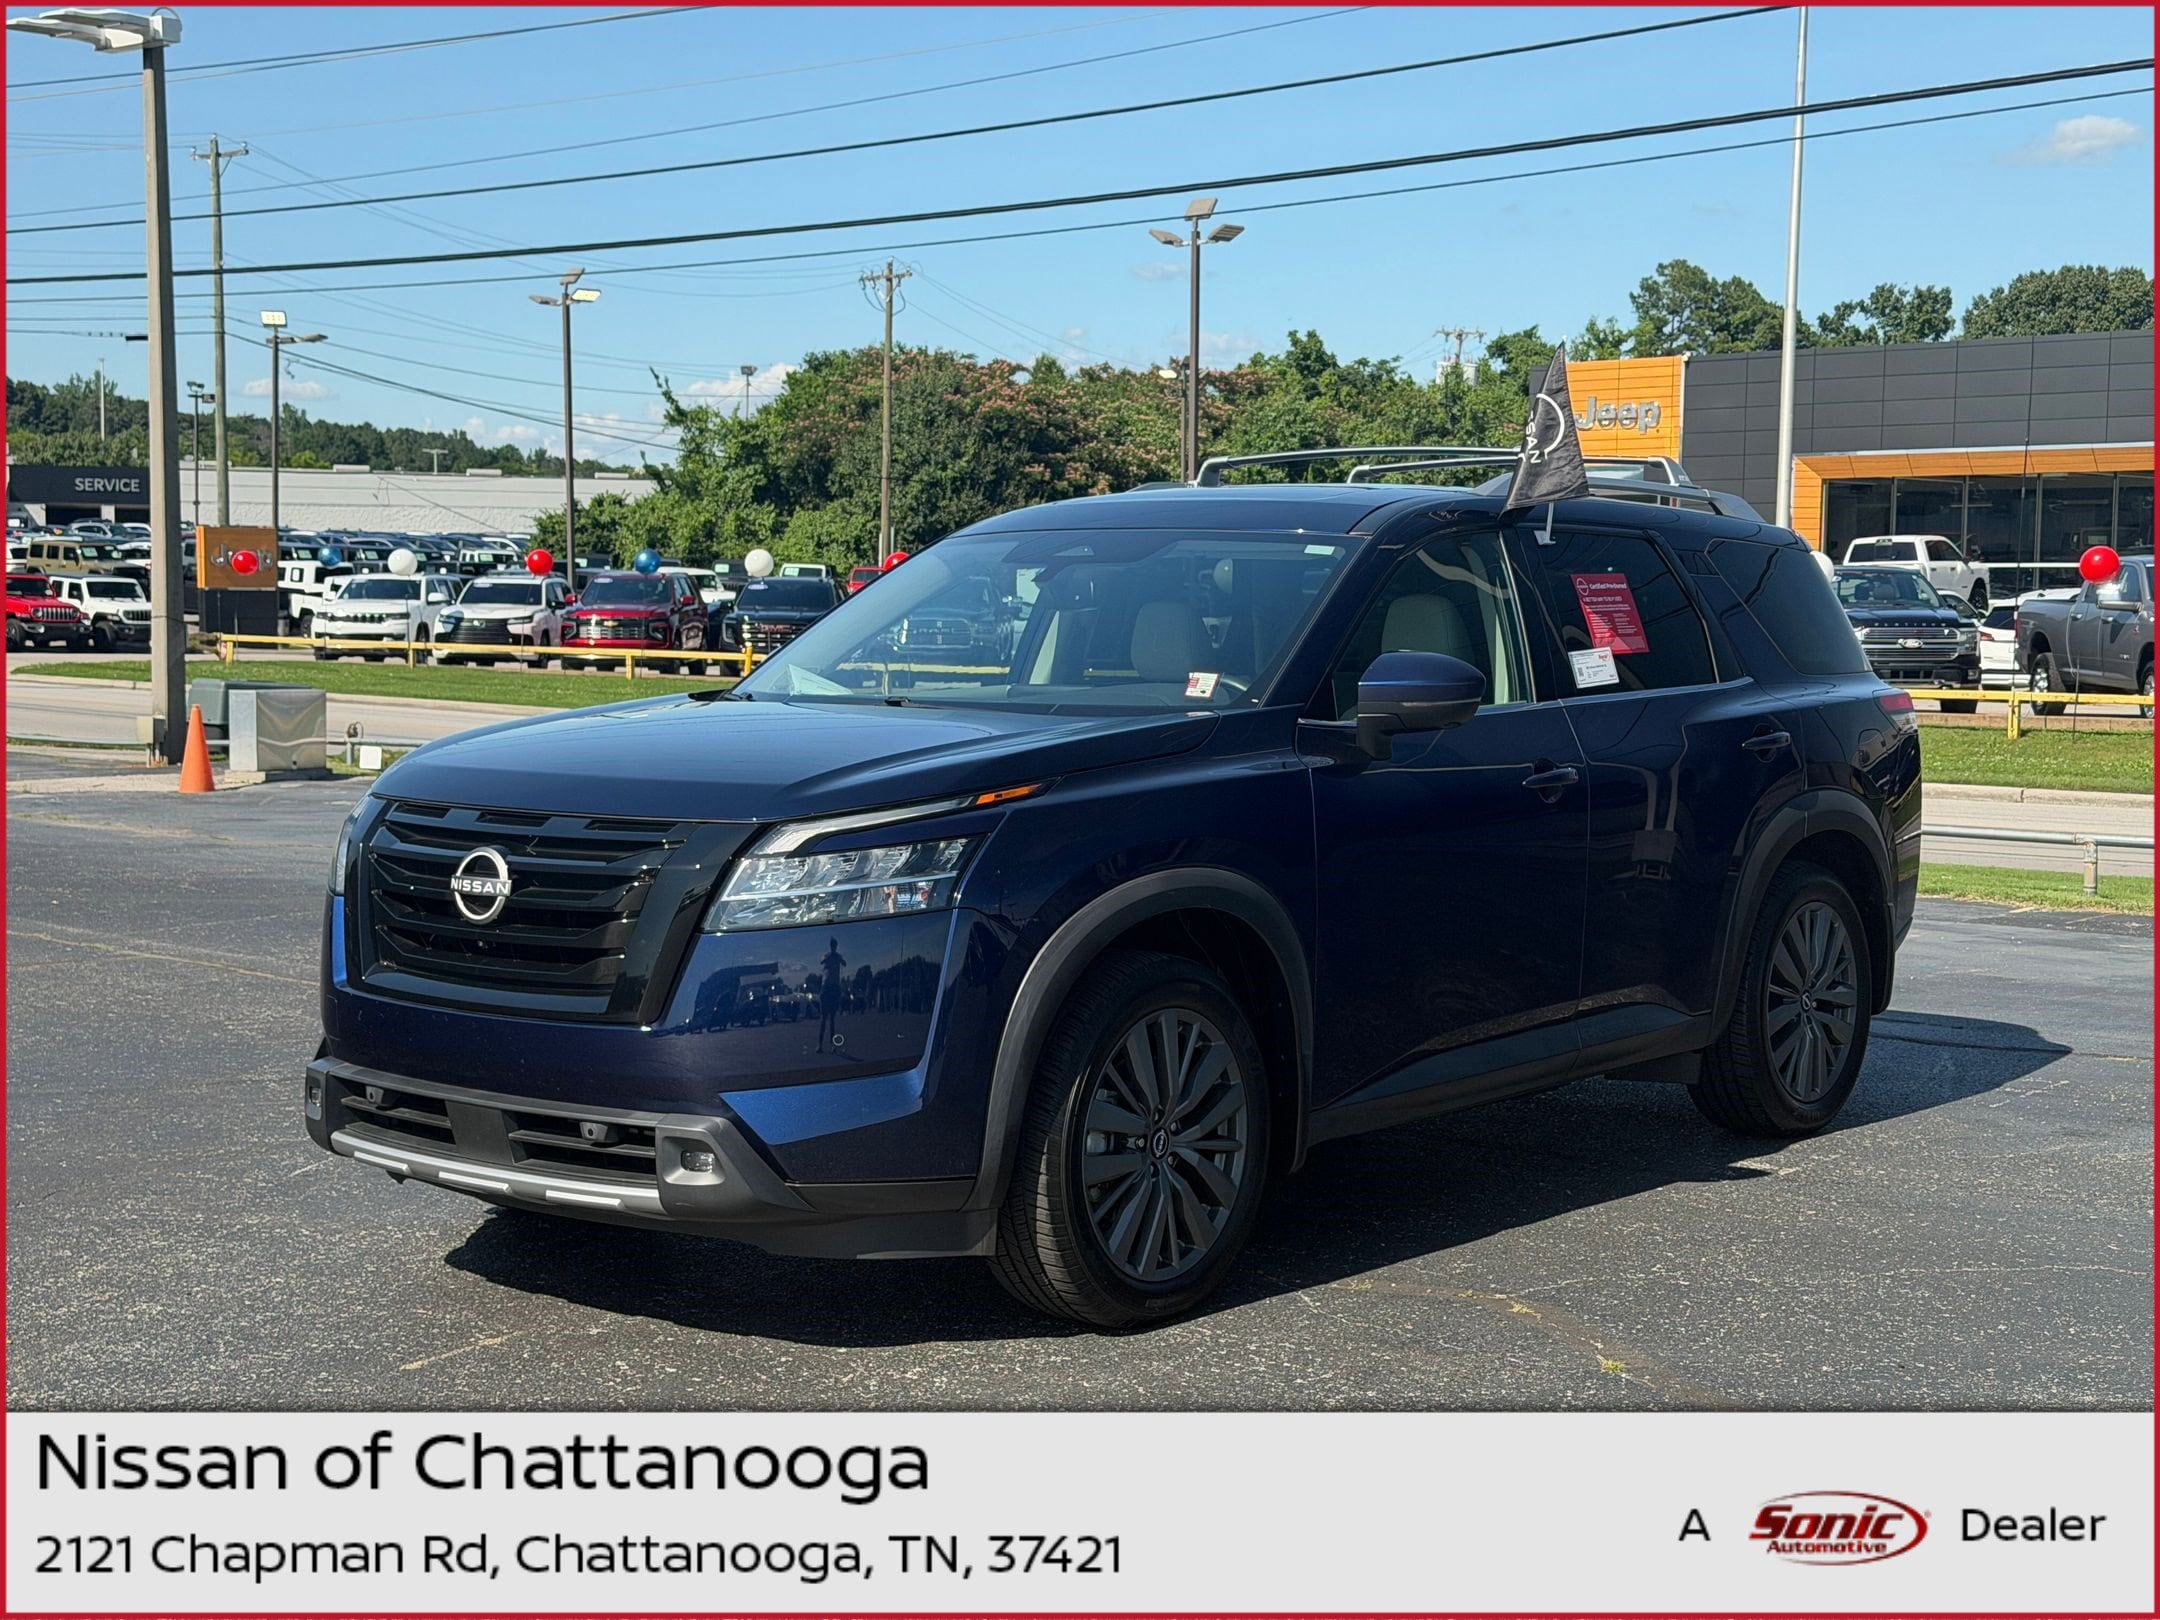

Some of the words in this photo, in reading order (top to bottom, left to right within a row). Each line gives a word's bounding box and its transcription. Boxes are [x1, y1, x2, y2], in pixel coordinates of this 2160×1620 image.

[1575, 397, 1661, 435] Jeep
[74, 477, 141, 493] SERVICE
[450, 878, 509, 894] NISSAN
